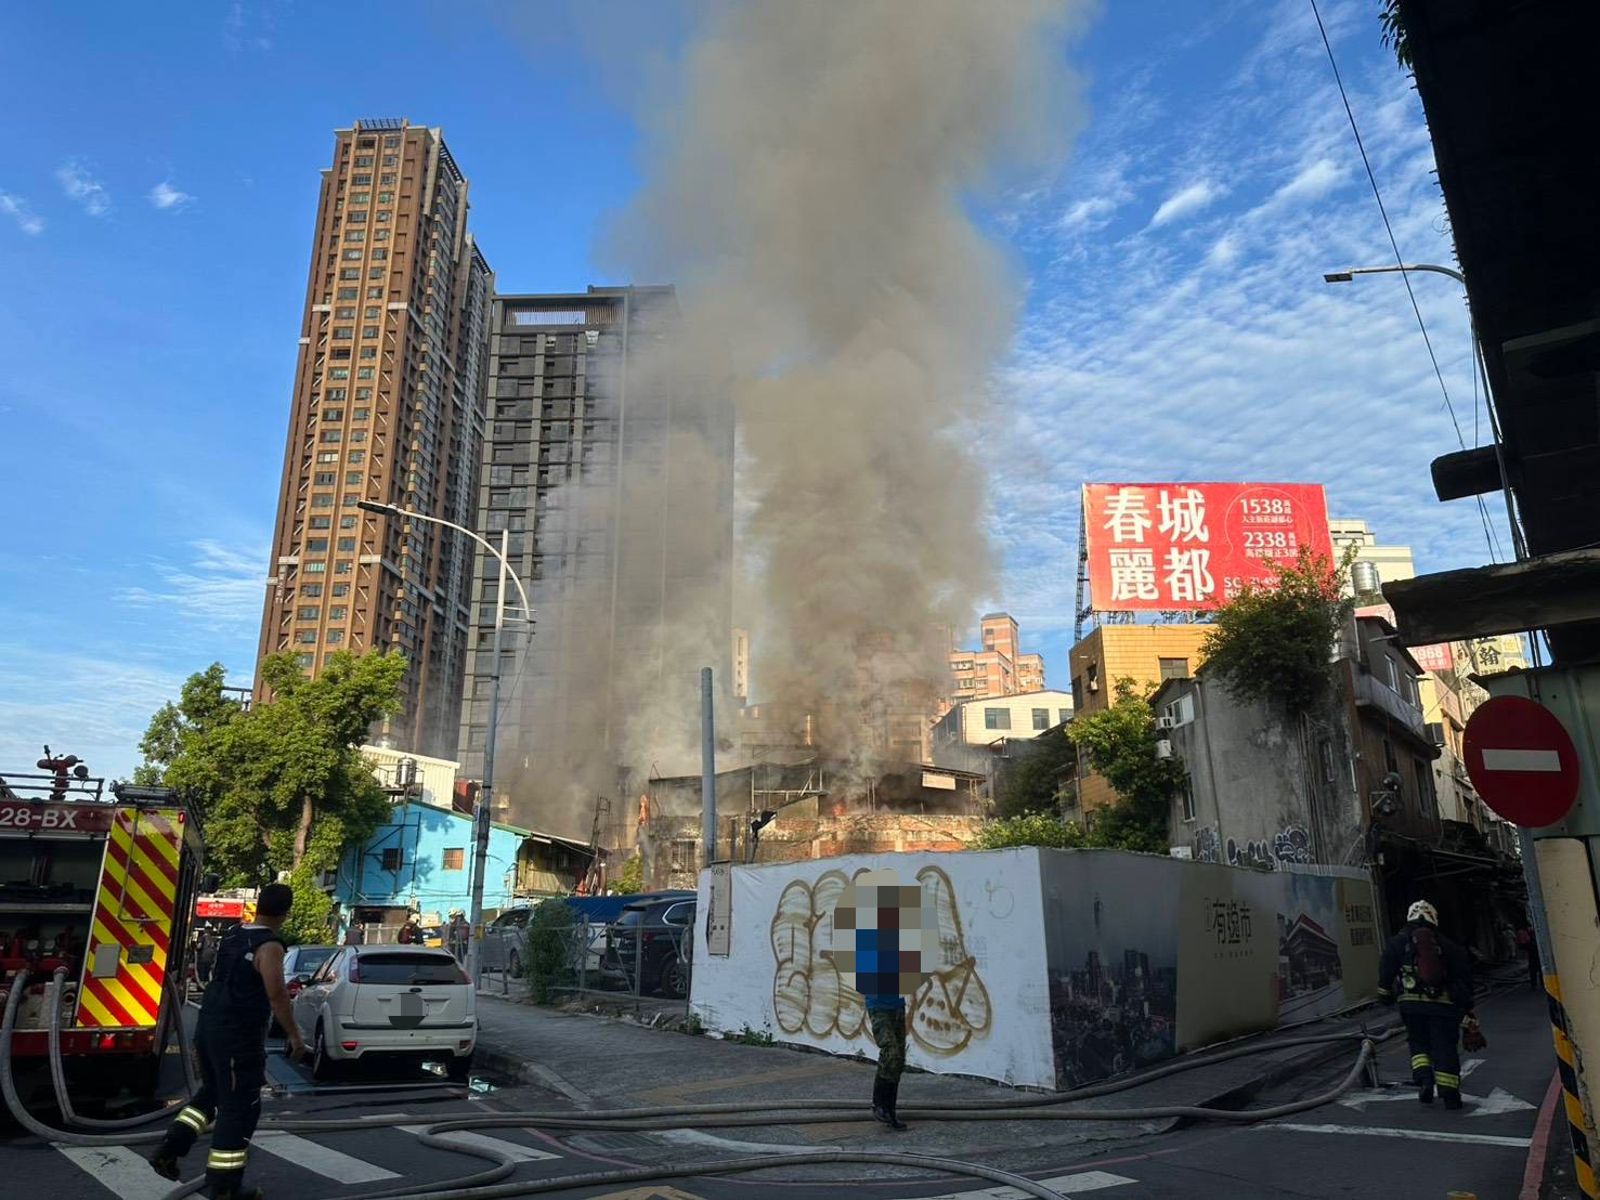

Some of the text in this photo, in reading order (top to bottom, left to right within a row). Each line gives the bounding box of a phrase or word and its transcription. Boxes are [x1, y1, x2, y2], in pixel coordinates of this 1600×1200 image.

[1104, 488, 1209, 543] 春城
[1240, 498, 1283, 514] 1538
[1243, 531, 1287, 548] 2338
[1109, 547, 1215, 602] 麗都
[0, 807, 79, 829] 28-BX
